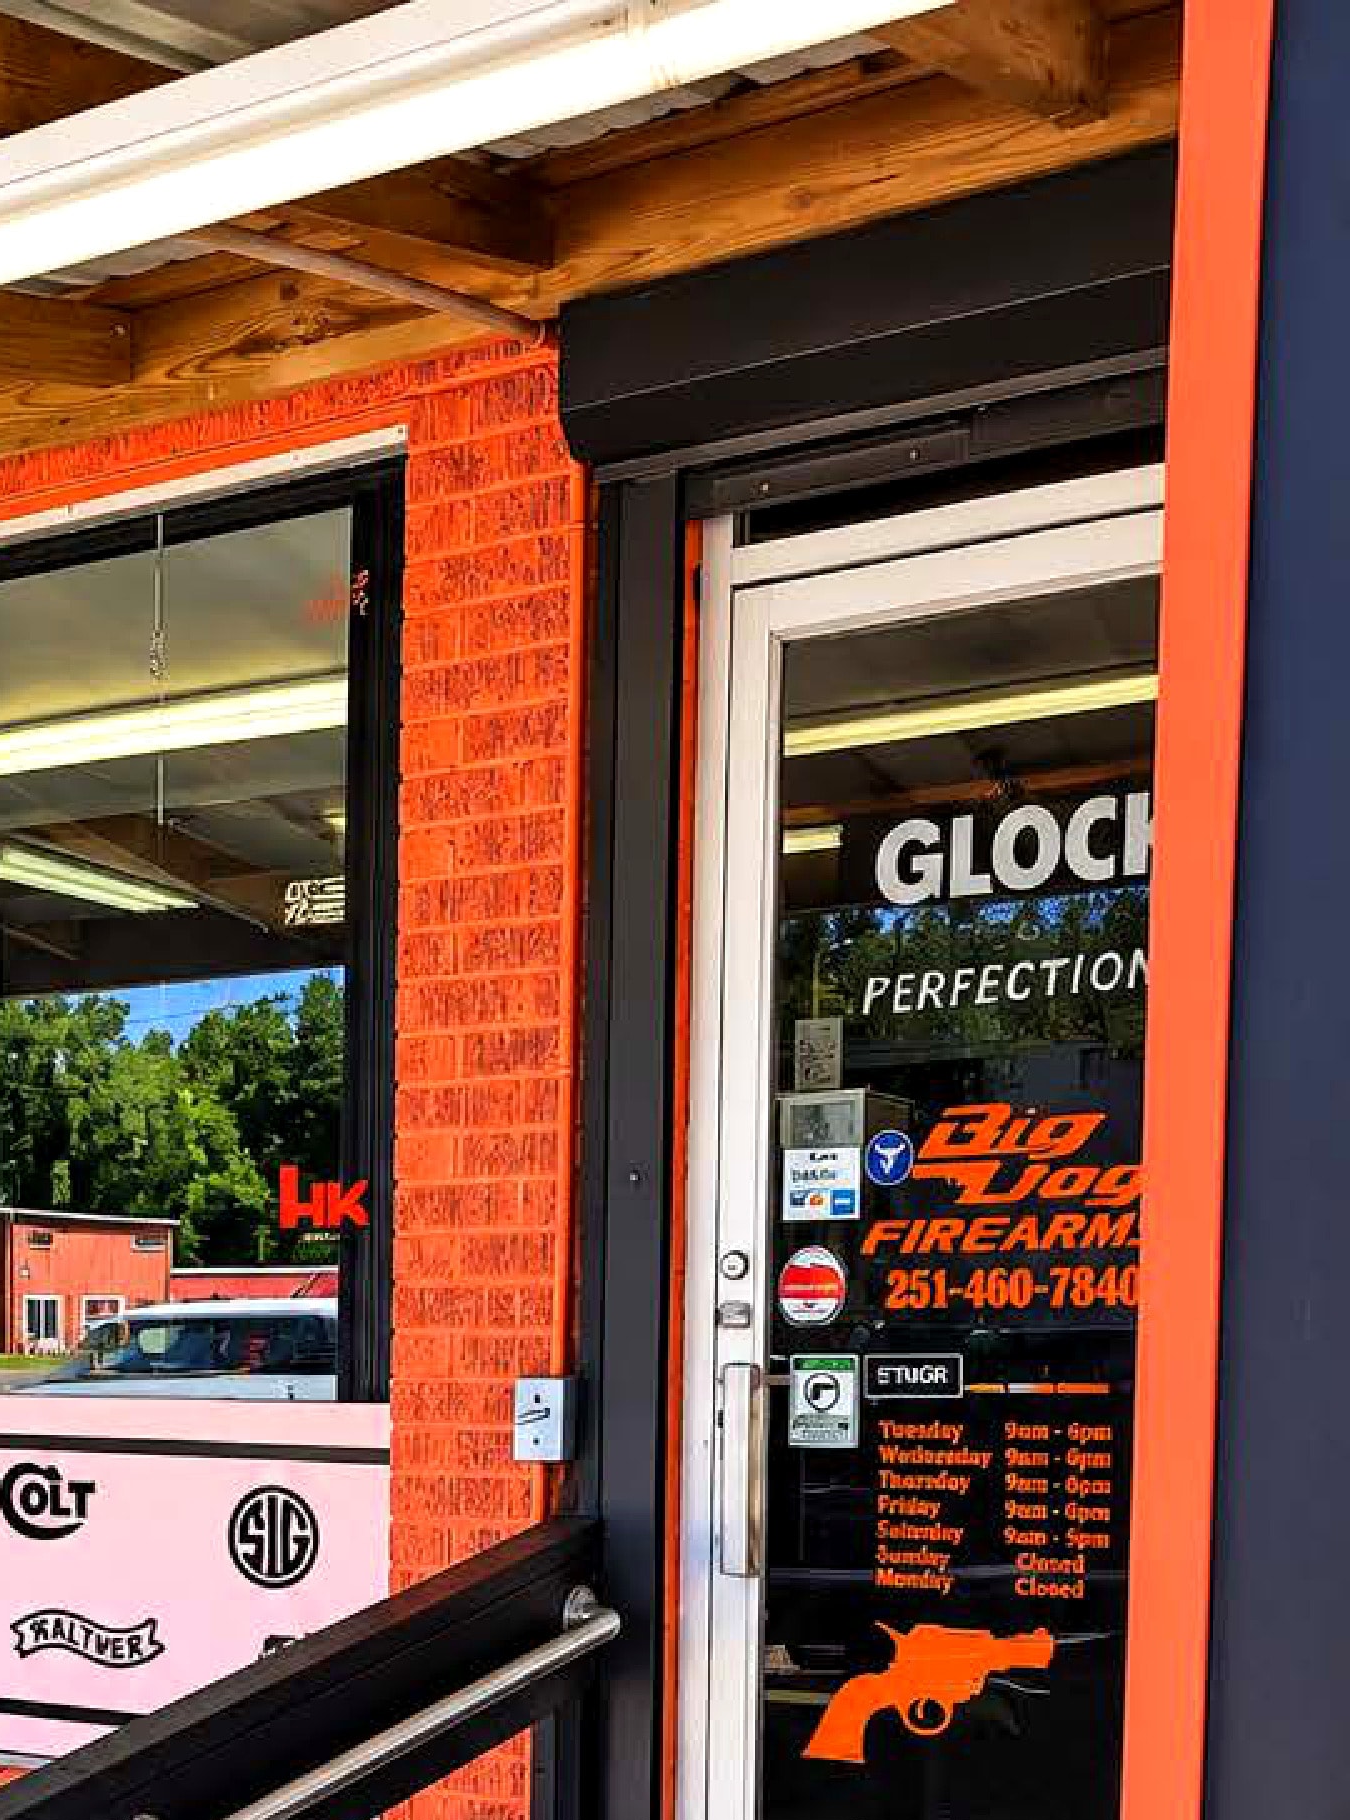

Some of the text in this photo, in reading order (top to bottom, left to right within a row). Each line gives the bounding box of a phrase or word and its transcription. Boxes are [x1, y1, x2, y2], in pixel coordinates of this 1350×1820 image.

[279, 1164, 370, 1229] HK
[860, 1213, 1143, 1256] FIREARM
[885, 1264, 1140, 1310] 251-460-7840
[878, 1420, 964, 1444] Tuesday
[0, 1462, 96, 1541] COLT
[877, 1494, 941, 1519] Friday
[236, 1491, 313, 1579] SIG
[1015, 1552, 1086, 1575] Closed
[1014, 1576, 1086, 1600] Closed
